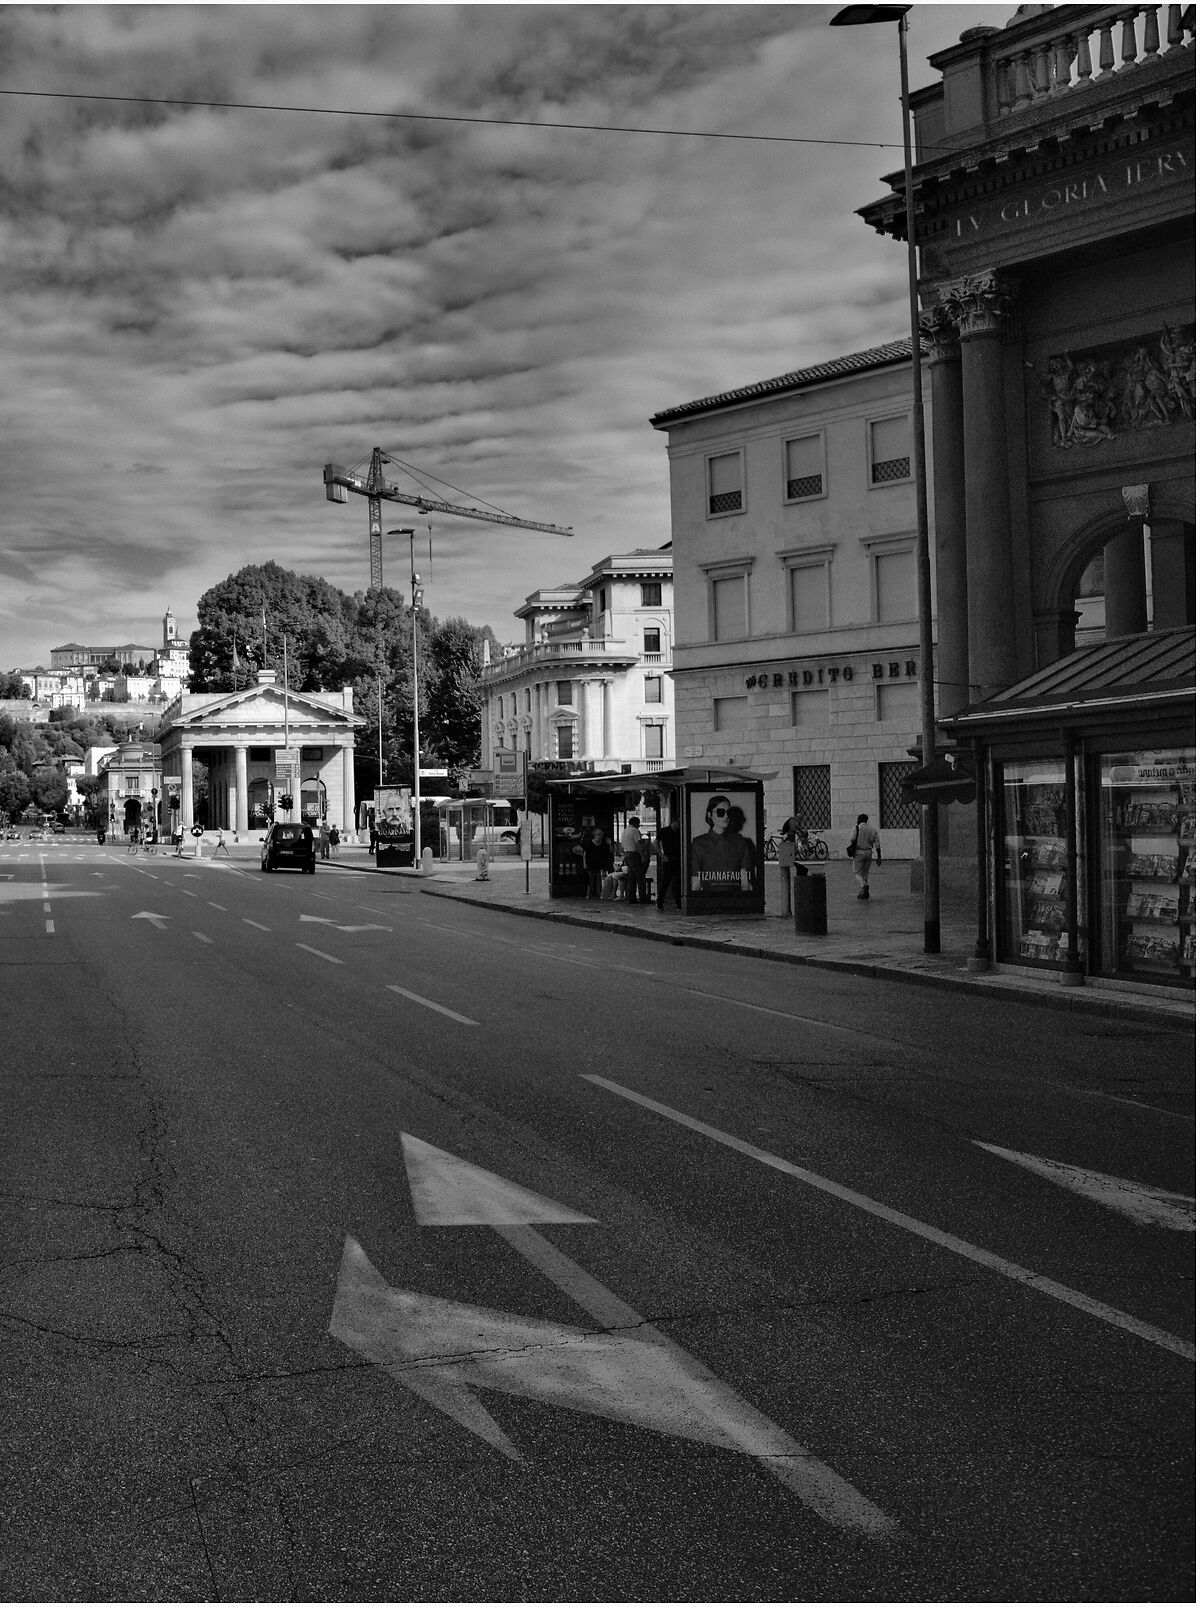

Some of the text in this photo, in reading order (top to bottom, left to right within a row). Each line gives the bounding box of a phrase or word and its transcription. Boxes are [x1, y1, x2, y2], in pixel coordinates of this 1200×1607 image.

[1001, 173, 1107, 221] GLORIA
[372, 523, 380, 532] A
[758, 666, 854, 689] CREDITO
